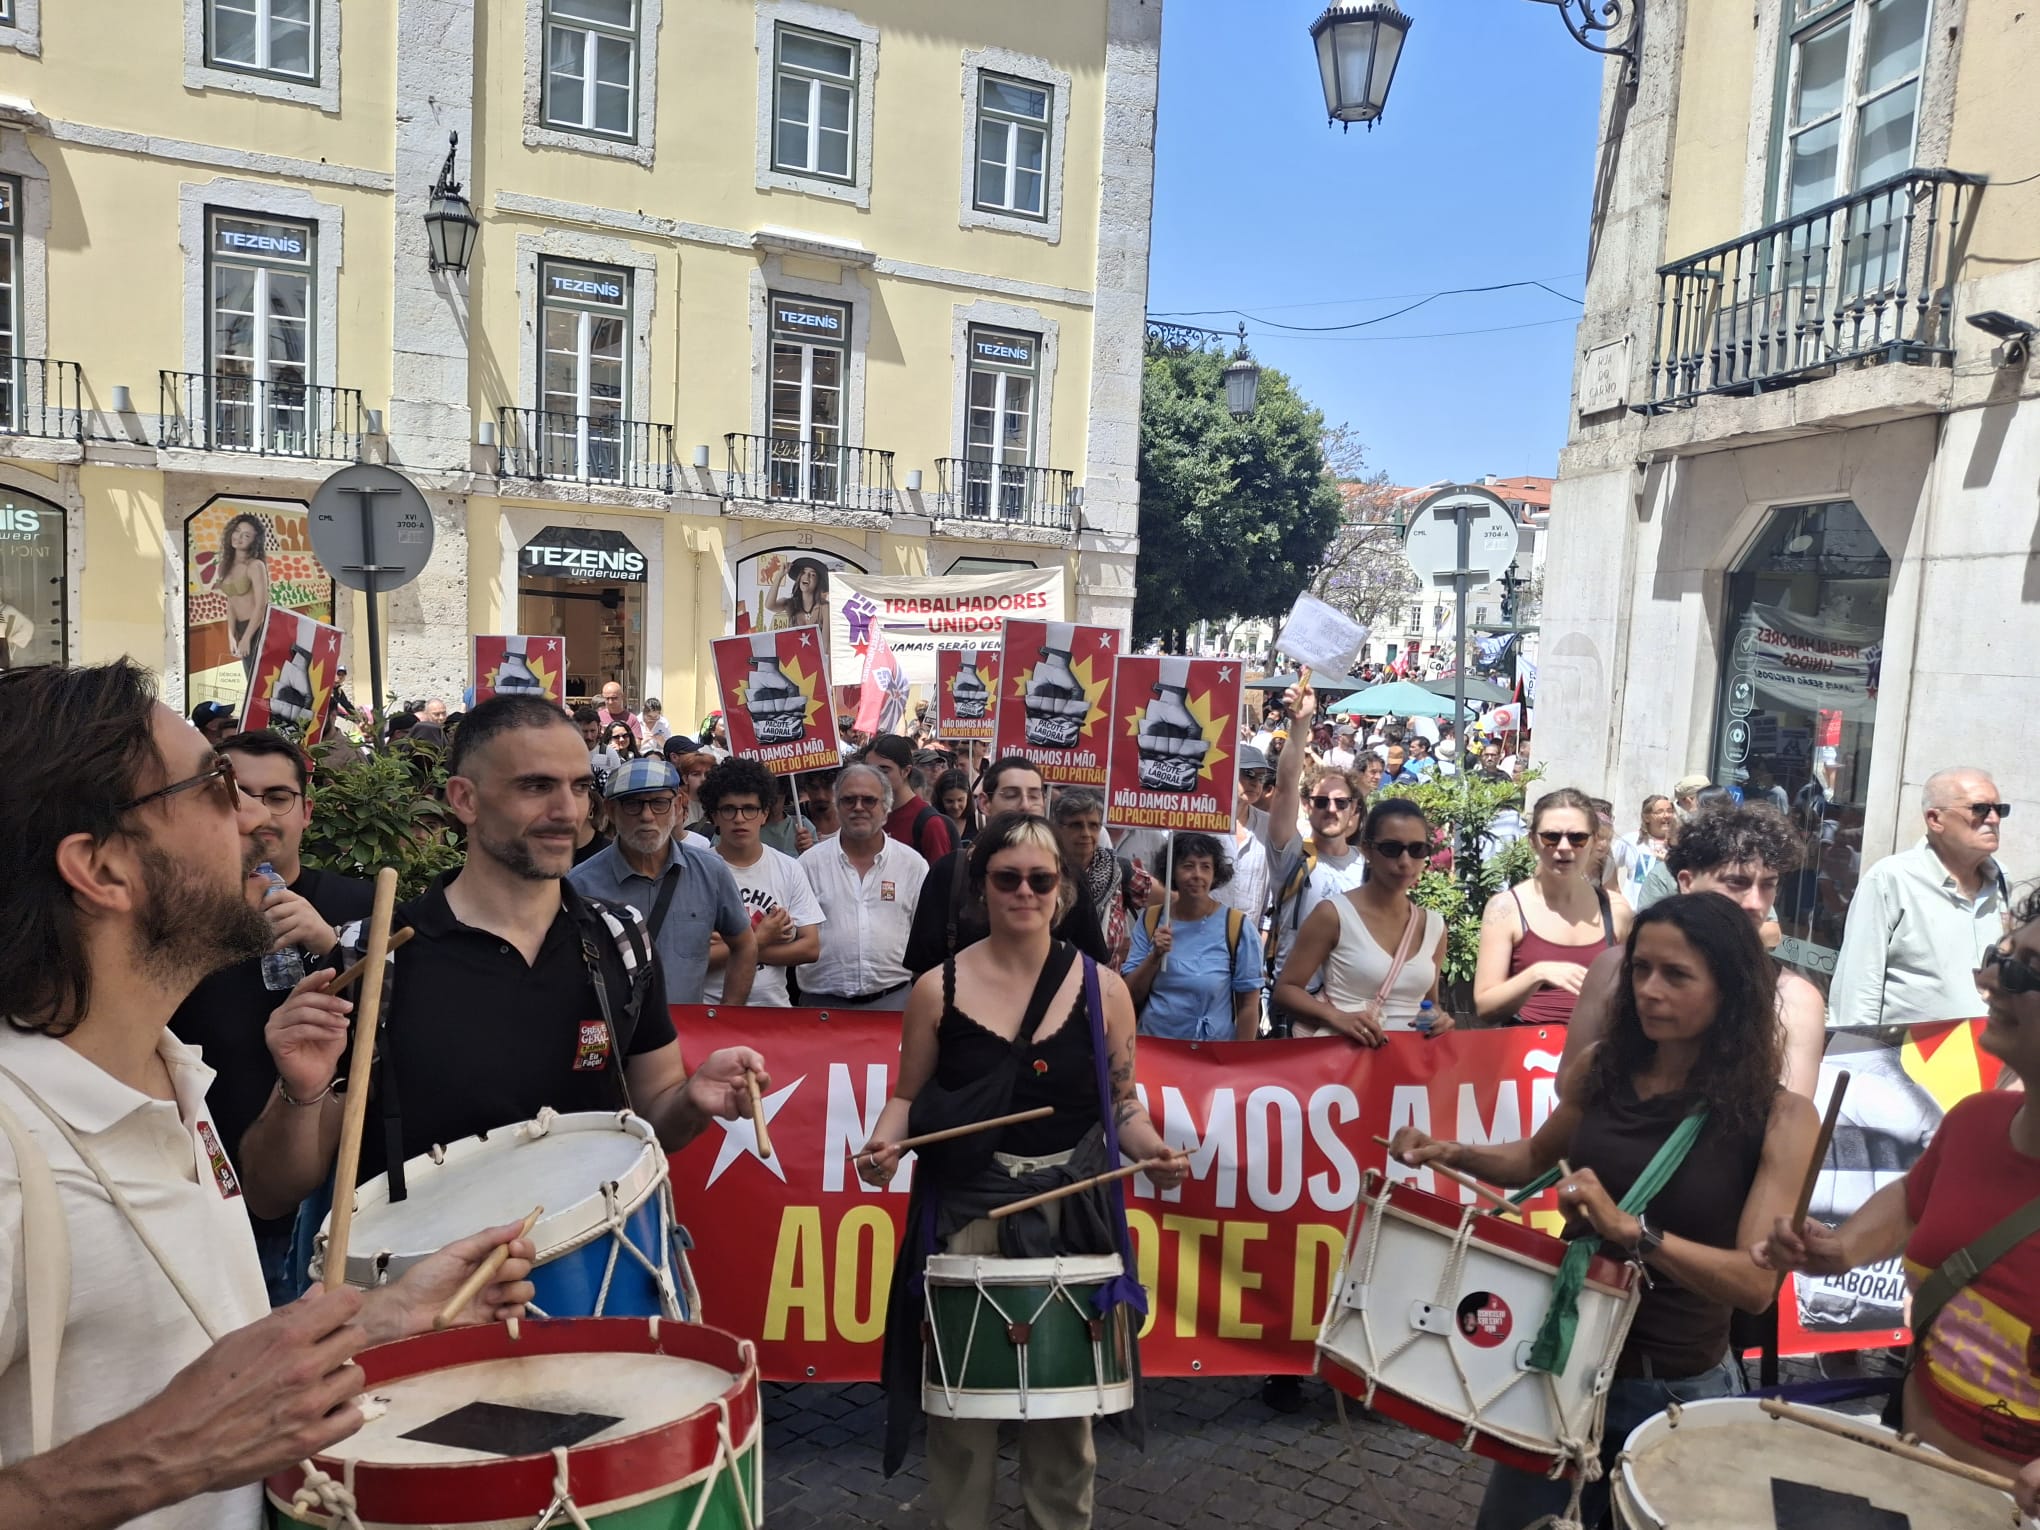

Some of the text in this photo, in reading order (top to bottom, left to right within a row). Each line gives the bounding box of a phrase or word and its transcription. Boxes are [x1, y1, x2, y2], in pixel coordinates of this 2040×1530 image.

[571, 568, 643, 580] underwear
[884, 592, 1047, 614] TRABALHADORES
[928, 616, 1002, 633] UNIDOS
[890, 643, 934, 652] JAMAIS
[938, 640, 977, 651] SERÃO
[764, 720, 790, 729] PACOTE
[943, 718, 955, 729] NÃO
[956, 719, 976, 729] DAMOS
[1038, 718, 1064, 732] PACOTE
[763, 726, 792, 736] LABORAL
[950, 728, 971, 737] PACOTE
[973, 729, 981, 737] DO
[1034, 726, 1065, 741] LABORAL
[760, 744, 794, 761] DAMOS
[795, 740, 804, 755] A
[804, 737, 825, 755] MÃO
[789, 754, 802, 770] DO
[803, 748, 839, 768] PATRÃO
[1026, 750, 1062, 765] DAMOS
[1063, 751, 1072, 765] A
[1072, 750, 1096, 768] MÃO
[1052, 766, 1067, 779] DO
[1152, 761, 1182, 775] PACOTE
[1148, 768, 1181, 784] LABORAL
[1114, 788, 1217, 813] NÃO DAMOS A MÃO
[1108, 806, 1231, 831] AO PACOTE DO PATRÃO
[581, 1023, 607, 1037] GREVE
[581, 1031, 610, 1045] GERAL
[1386, 1085, 1436, 1195] A
[762, 1204, 895, 1344] AO
